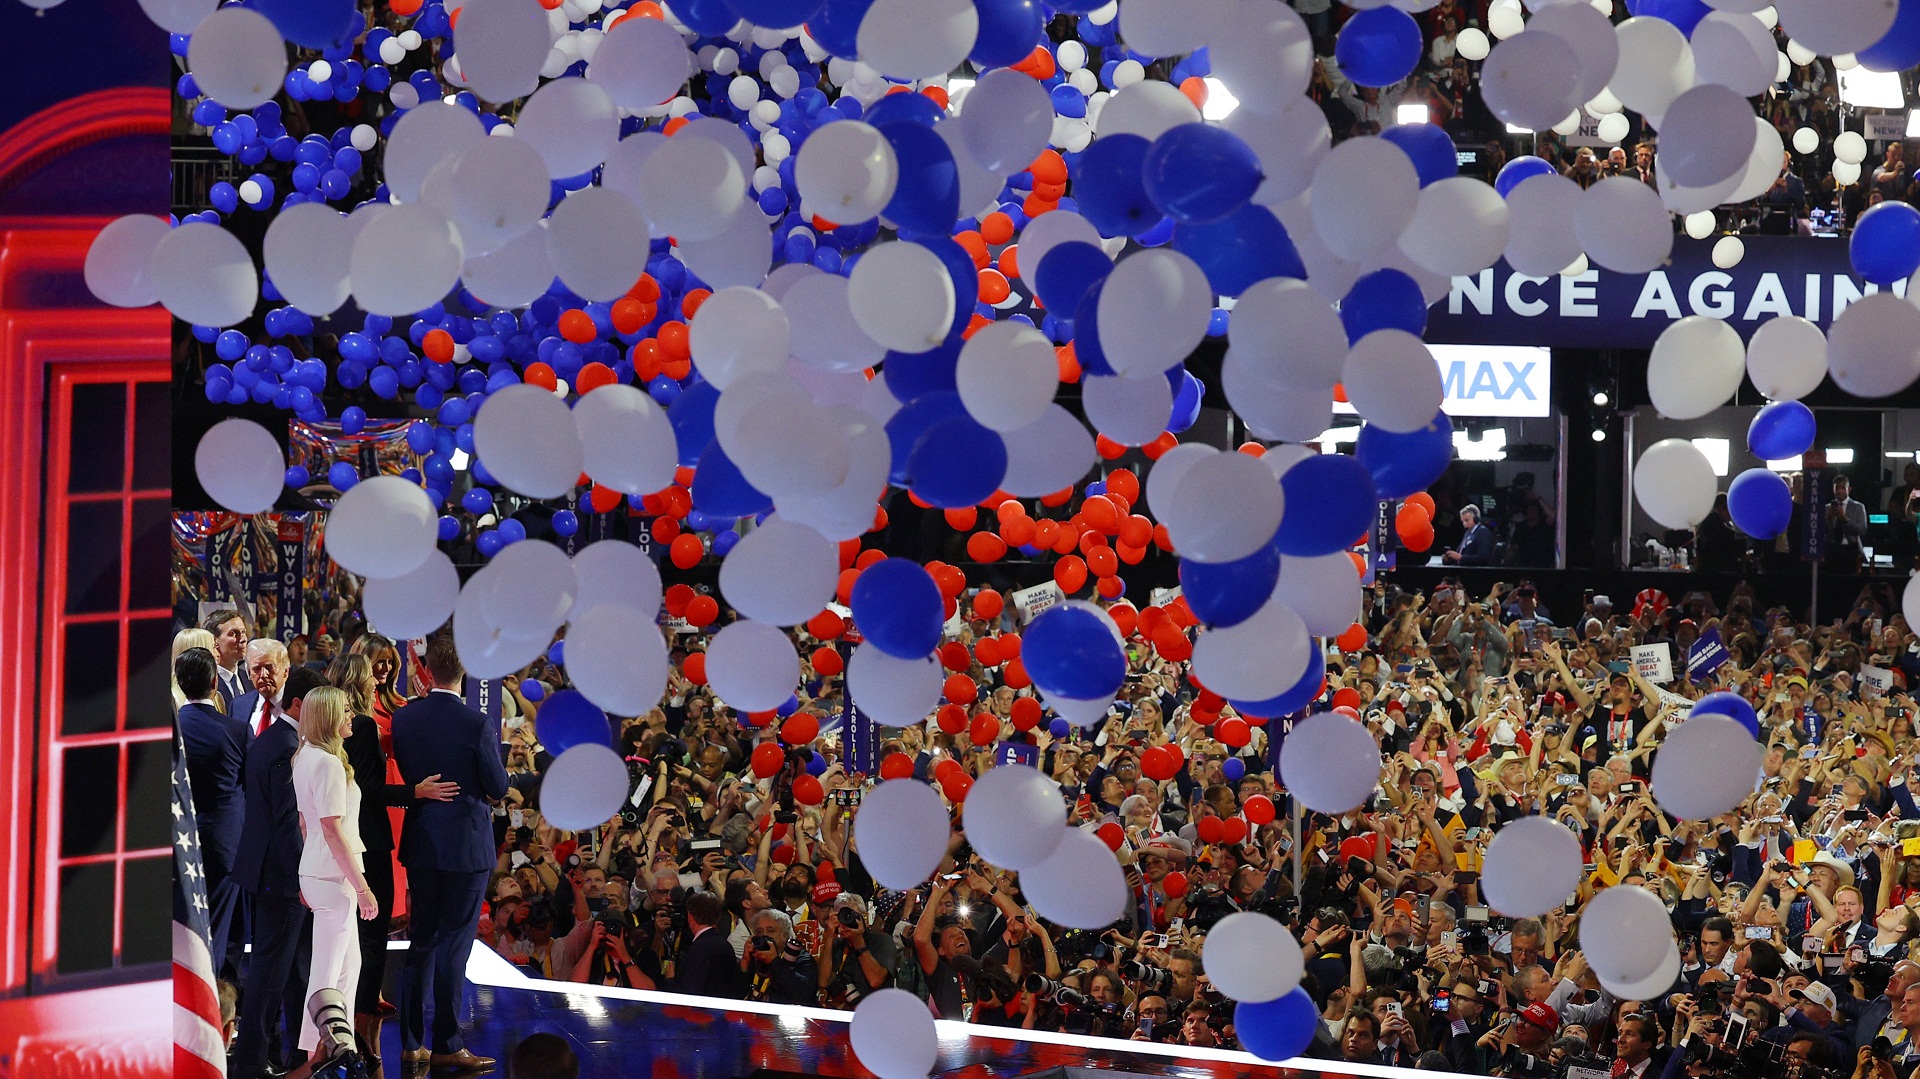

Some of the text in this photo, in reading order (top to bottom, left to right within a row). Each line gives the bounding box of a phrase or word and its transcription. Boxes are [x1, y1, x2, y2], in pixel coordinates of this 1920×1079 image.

[1874, 127, 1903, 135] NEWS
[1809, 471, 1820, 554] WASHINGTON
[1028, 589, 1047, 599] MAKE
[1025, 594, 1055, 607] AMERICA
[1030, 600, 1052, 611] GREAT
[1701, 641, 1717, 655] BACK
[1706, 643, 1723, 659] SENSE
[1636, 657, 1661, 665] AMERICA
[1865, 675, 1883, 688] FIRE
[1576, 1067, 1605, 1077] NETWORK
